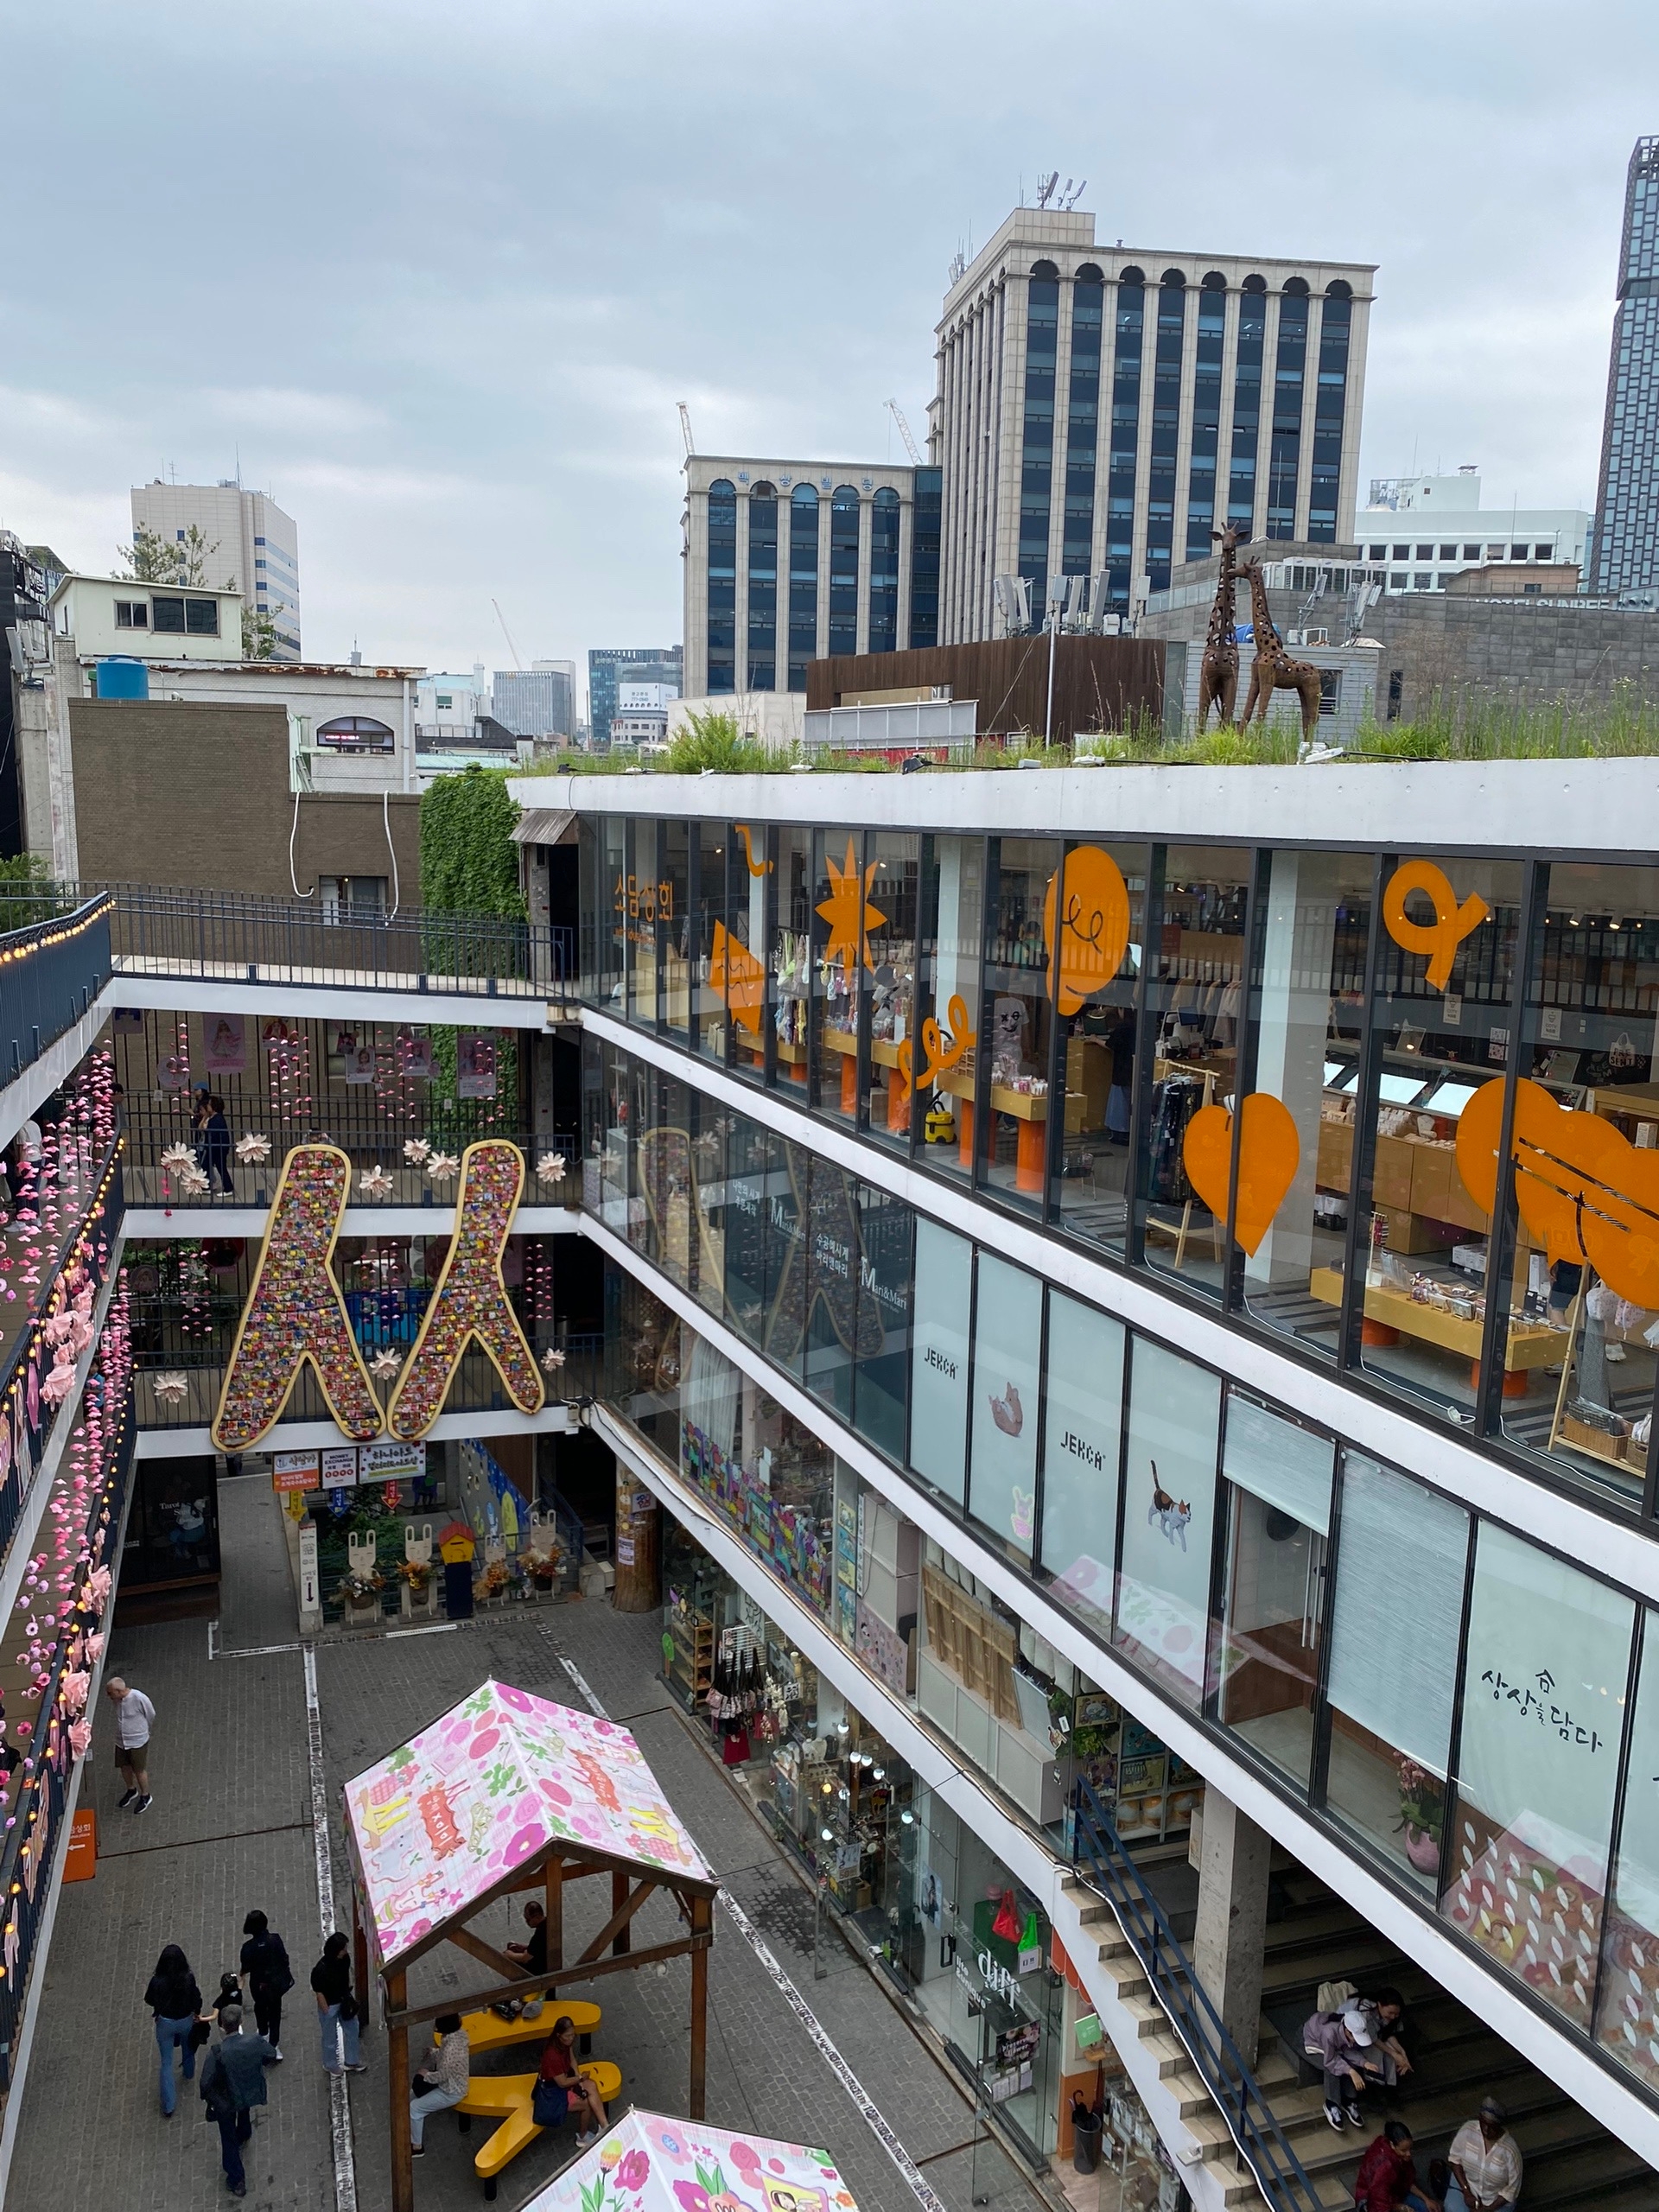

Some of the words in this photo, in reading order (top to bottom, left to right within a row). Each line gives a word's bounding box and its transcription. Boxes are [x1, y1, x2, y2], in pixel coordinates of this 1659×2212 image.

[738, 471, 873, 491] 백상빌딩
[614, 874, 673, 923] 소담상회
[1611, 1056, 1634, 1067] SENT
[860, 1255, 907, 1311] Mari&Mari
[372, 1446, 413, 1460] 하나아트
[977, 1947, 1021, 2012] diff
